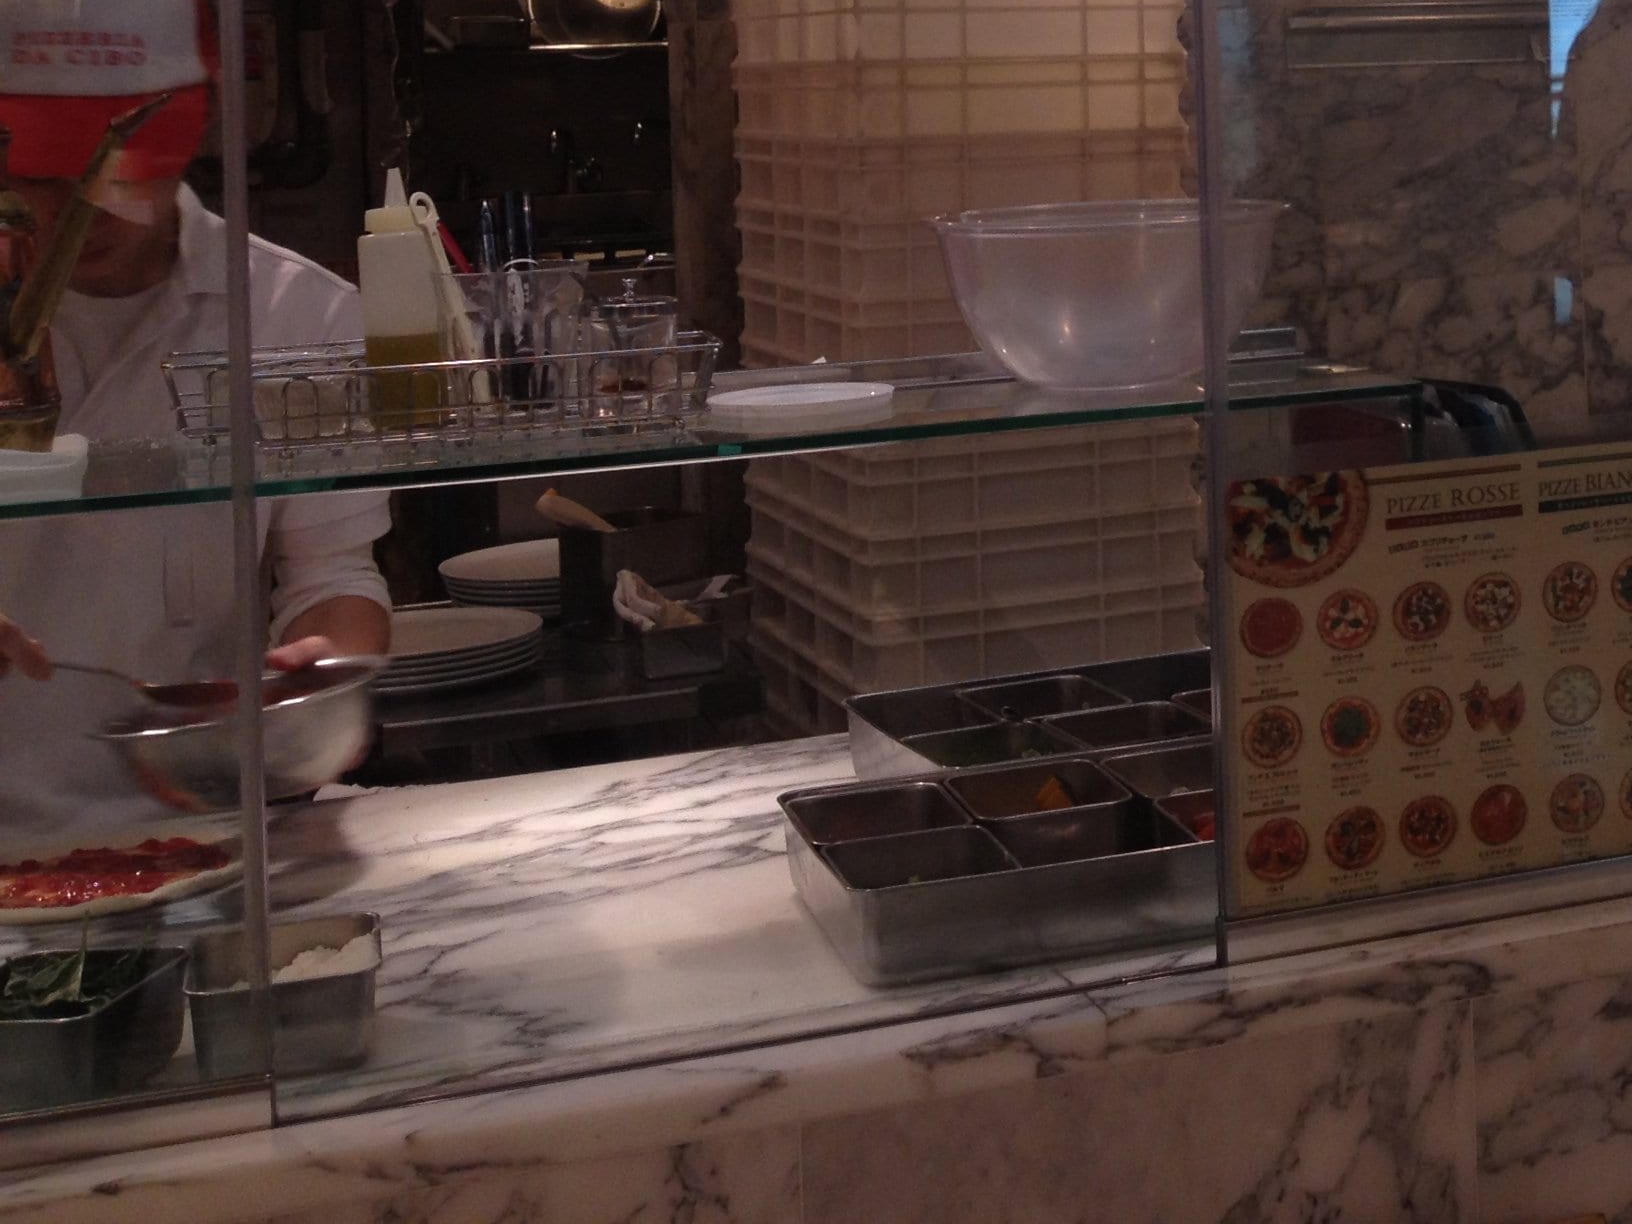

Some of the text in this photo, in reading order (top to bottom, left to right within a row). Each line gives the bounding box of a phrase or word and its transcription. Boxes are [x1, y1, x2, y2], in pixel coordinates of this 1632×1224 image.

[1386, 481, 1521, 514] PIZZE ROSSE
[1538, 478, 1582, 497] PIZZE
